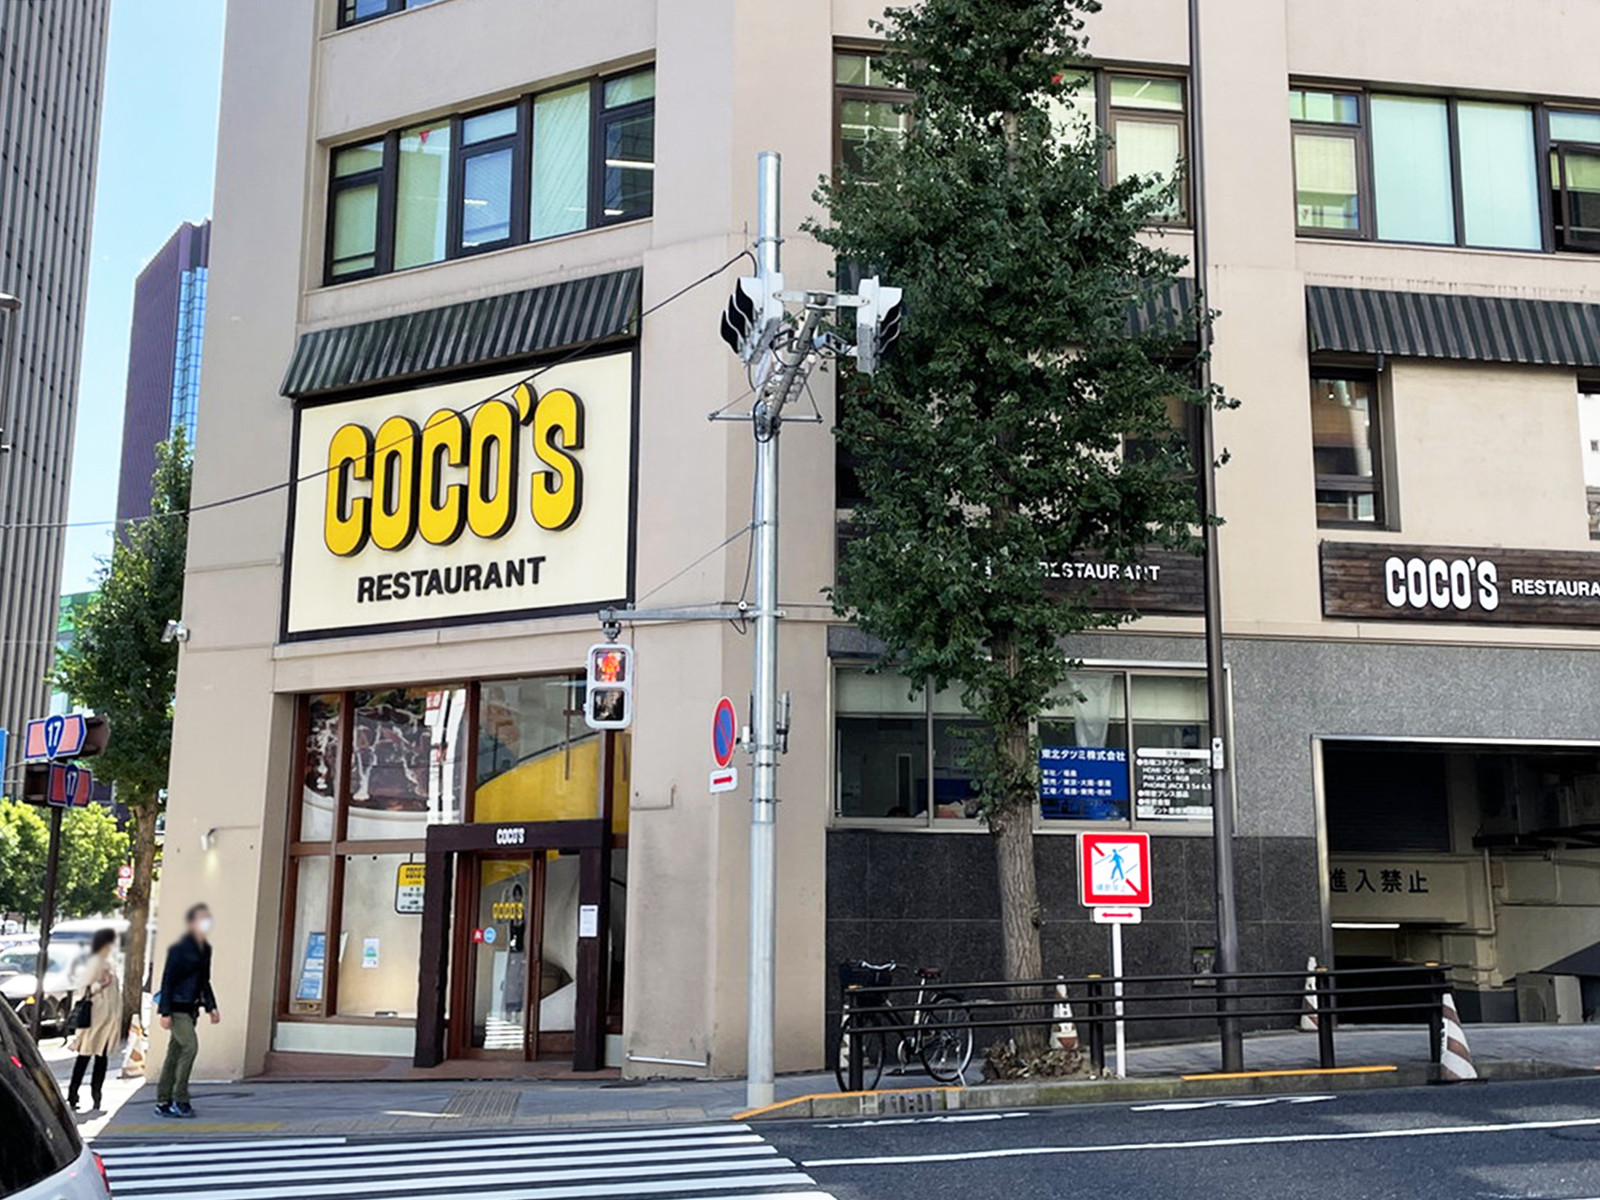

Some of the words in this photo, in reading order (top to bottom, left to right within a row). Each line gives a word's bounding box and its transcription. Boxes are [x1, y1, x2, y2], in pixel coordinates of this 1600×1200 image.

[324, 382, 585, 558] COCO'S
[357, 556, 546, 603] RESTAURANT
[1384, 555, 1499, 612] COCO'S
[1511, 579, 1600, 597] RESTAURA
[47, 721, 62, 747] 17
[67, 771, 78, 796] 17
[496, 827, 525, 845] COCO'S
[1329, 867, 1429, 893] 進入禁止
